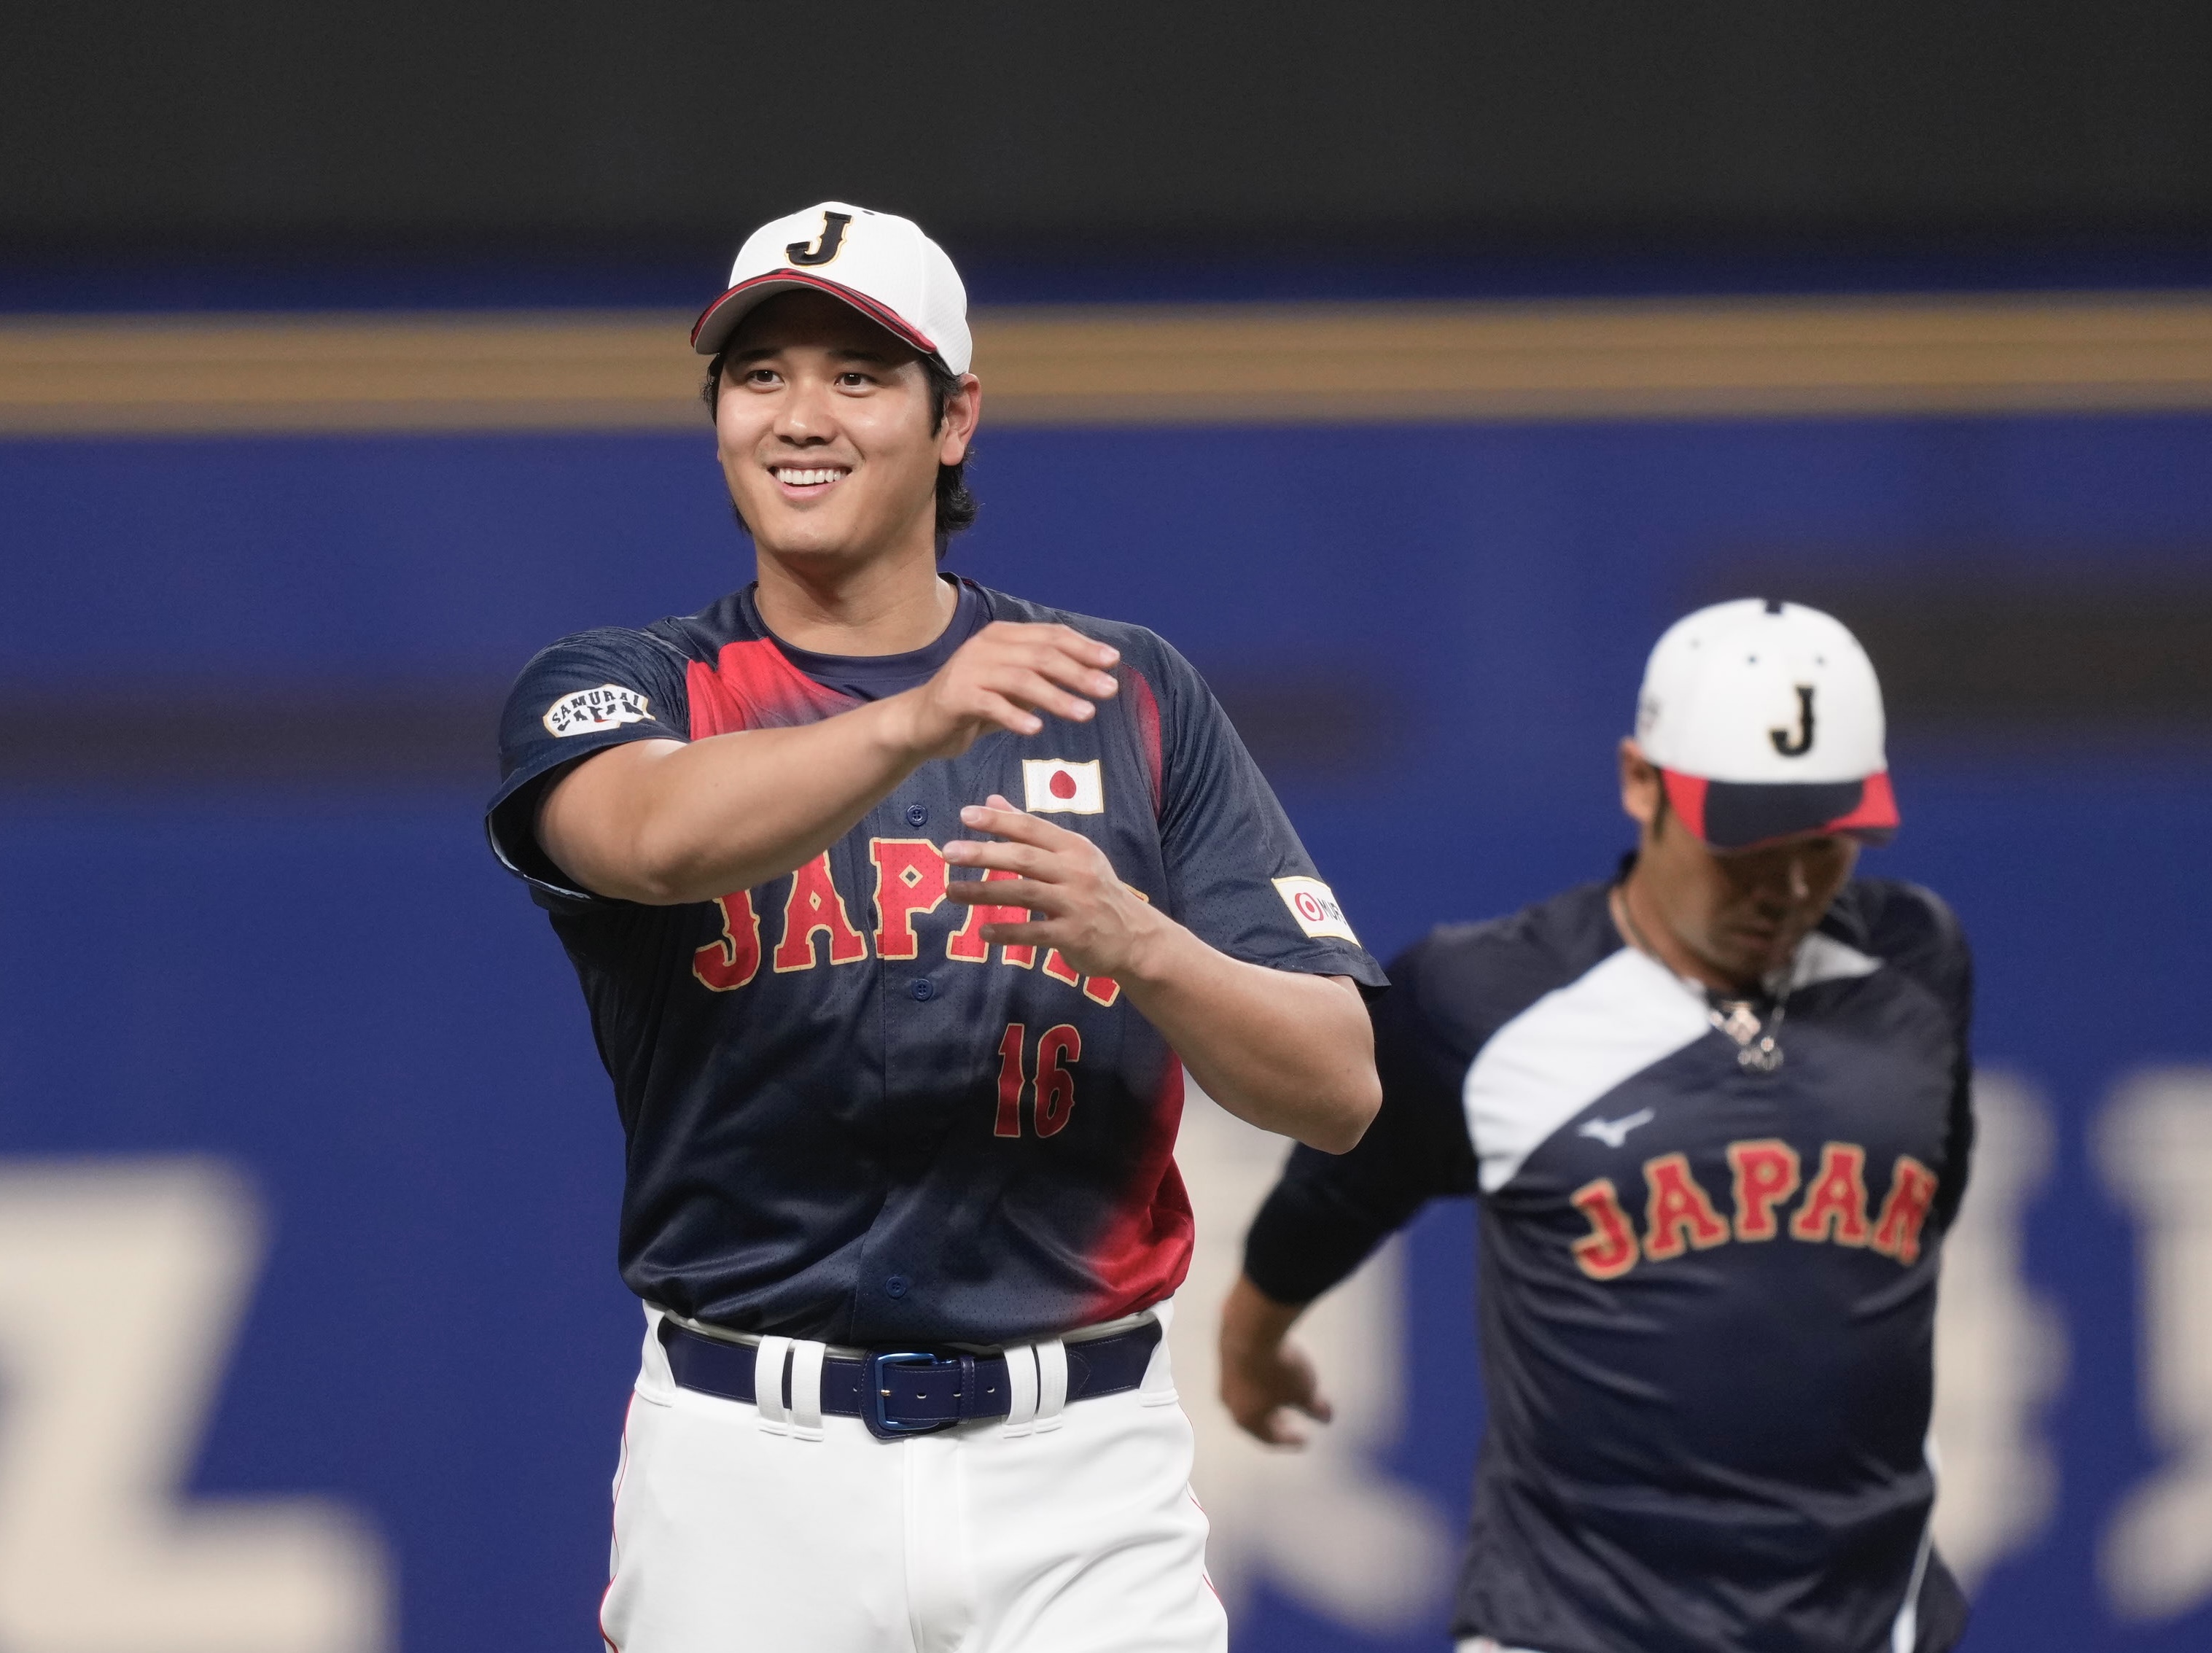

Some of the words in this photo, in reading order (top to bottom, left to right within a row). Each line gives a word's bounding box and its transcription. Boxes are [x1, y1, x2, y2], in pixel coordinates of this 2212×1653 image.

[785, 211, 853, 268] J
[552, 691, 639, 723] SAMURAI
[1768, 684, 1816, 758] J
[693, 837, 1148, 1007] JAPA
[994, 1023, 1082, 1138] 16
[1570, 1137, 1939, 1281] JAPAN
